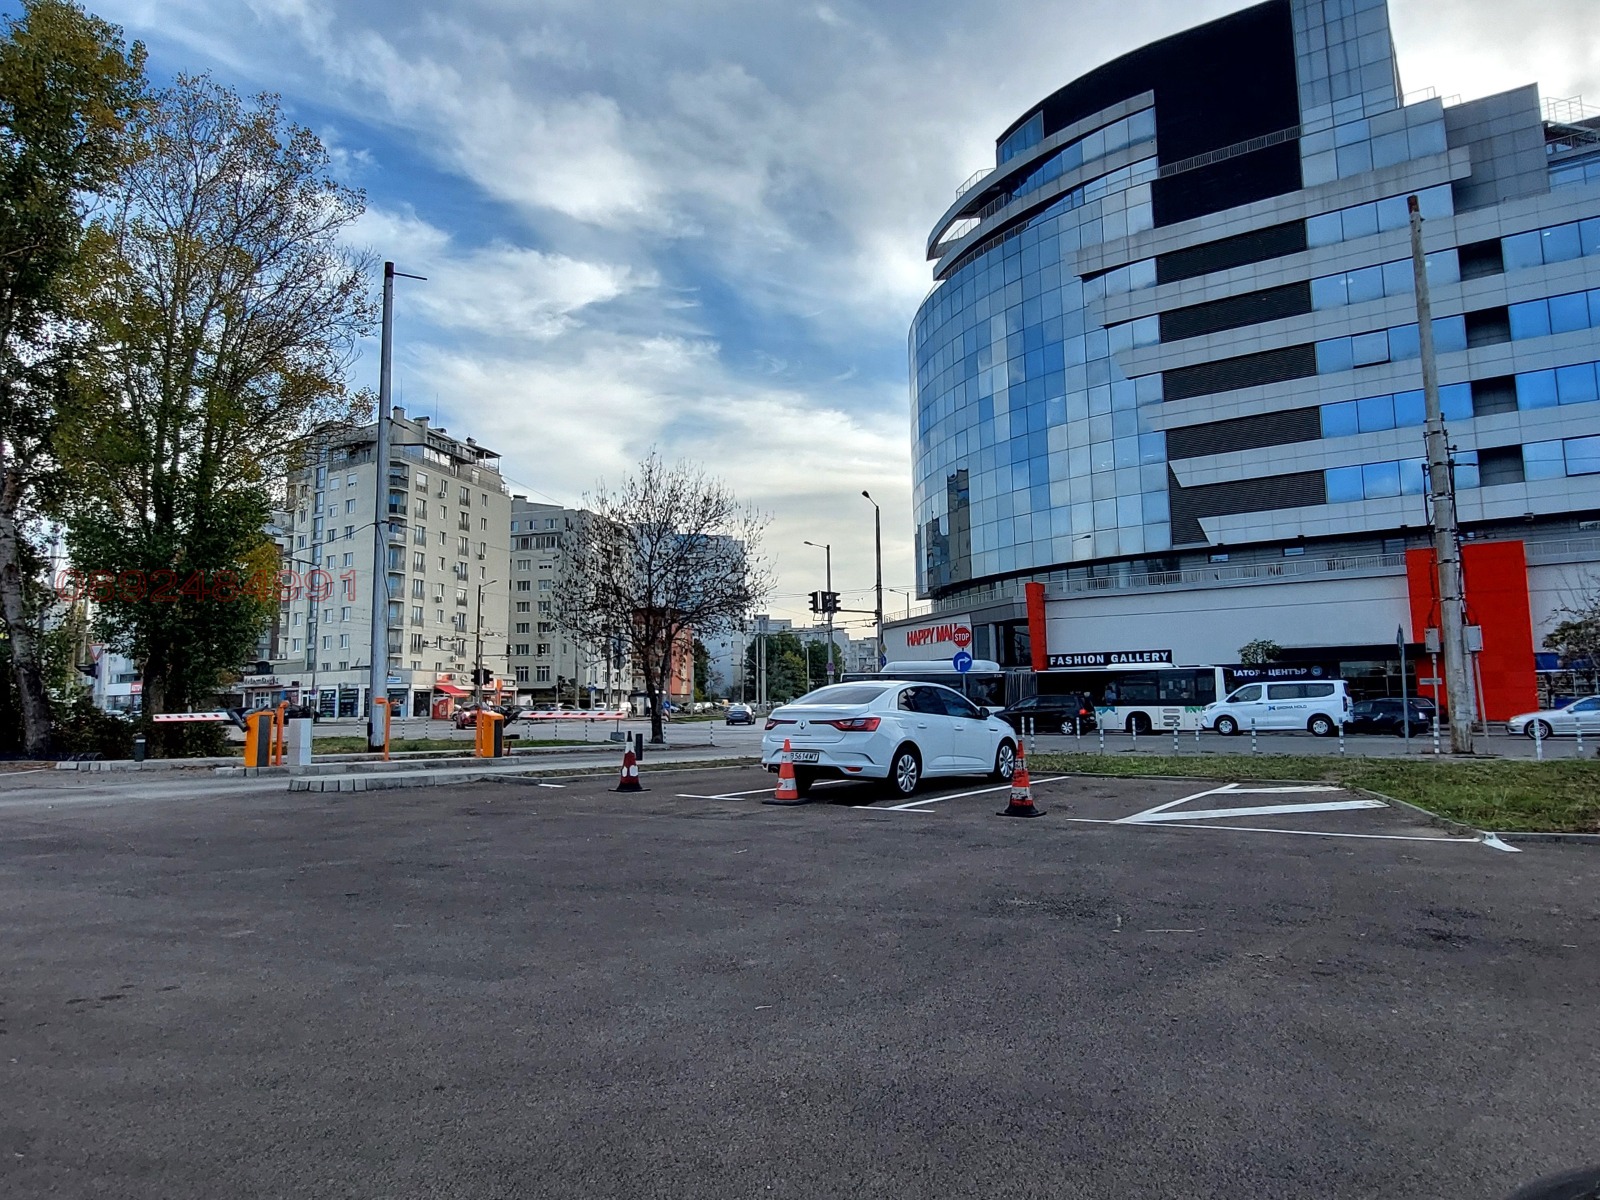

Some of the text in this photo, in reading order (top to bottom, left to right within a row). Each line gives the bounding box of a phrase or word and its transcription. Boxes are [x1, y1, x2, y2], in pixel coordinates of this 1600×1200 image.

[907, 627, 935, 647] HAPPY
[954, 633, 970, 642] STOP
[1050, 652, 1168, 666] FASHION GALLERY
[1268, 668, 1307, 677] ЦЕНТЪР
